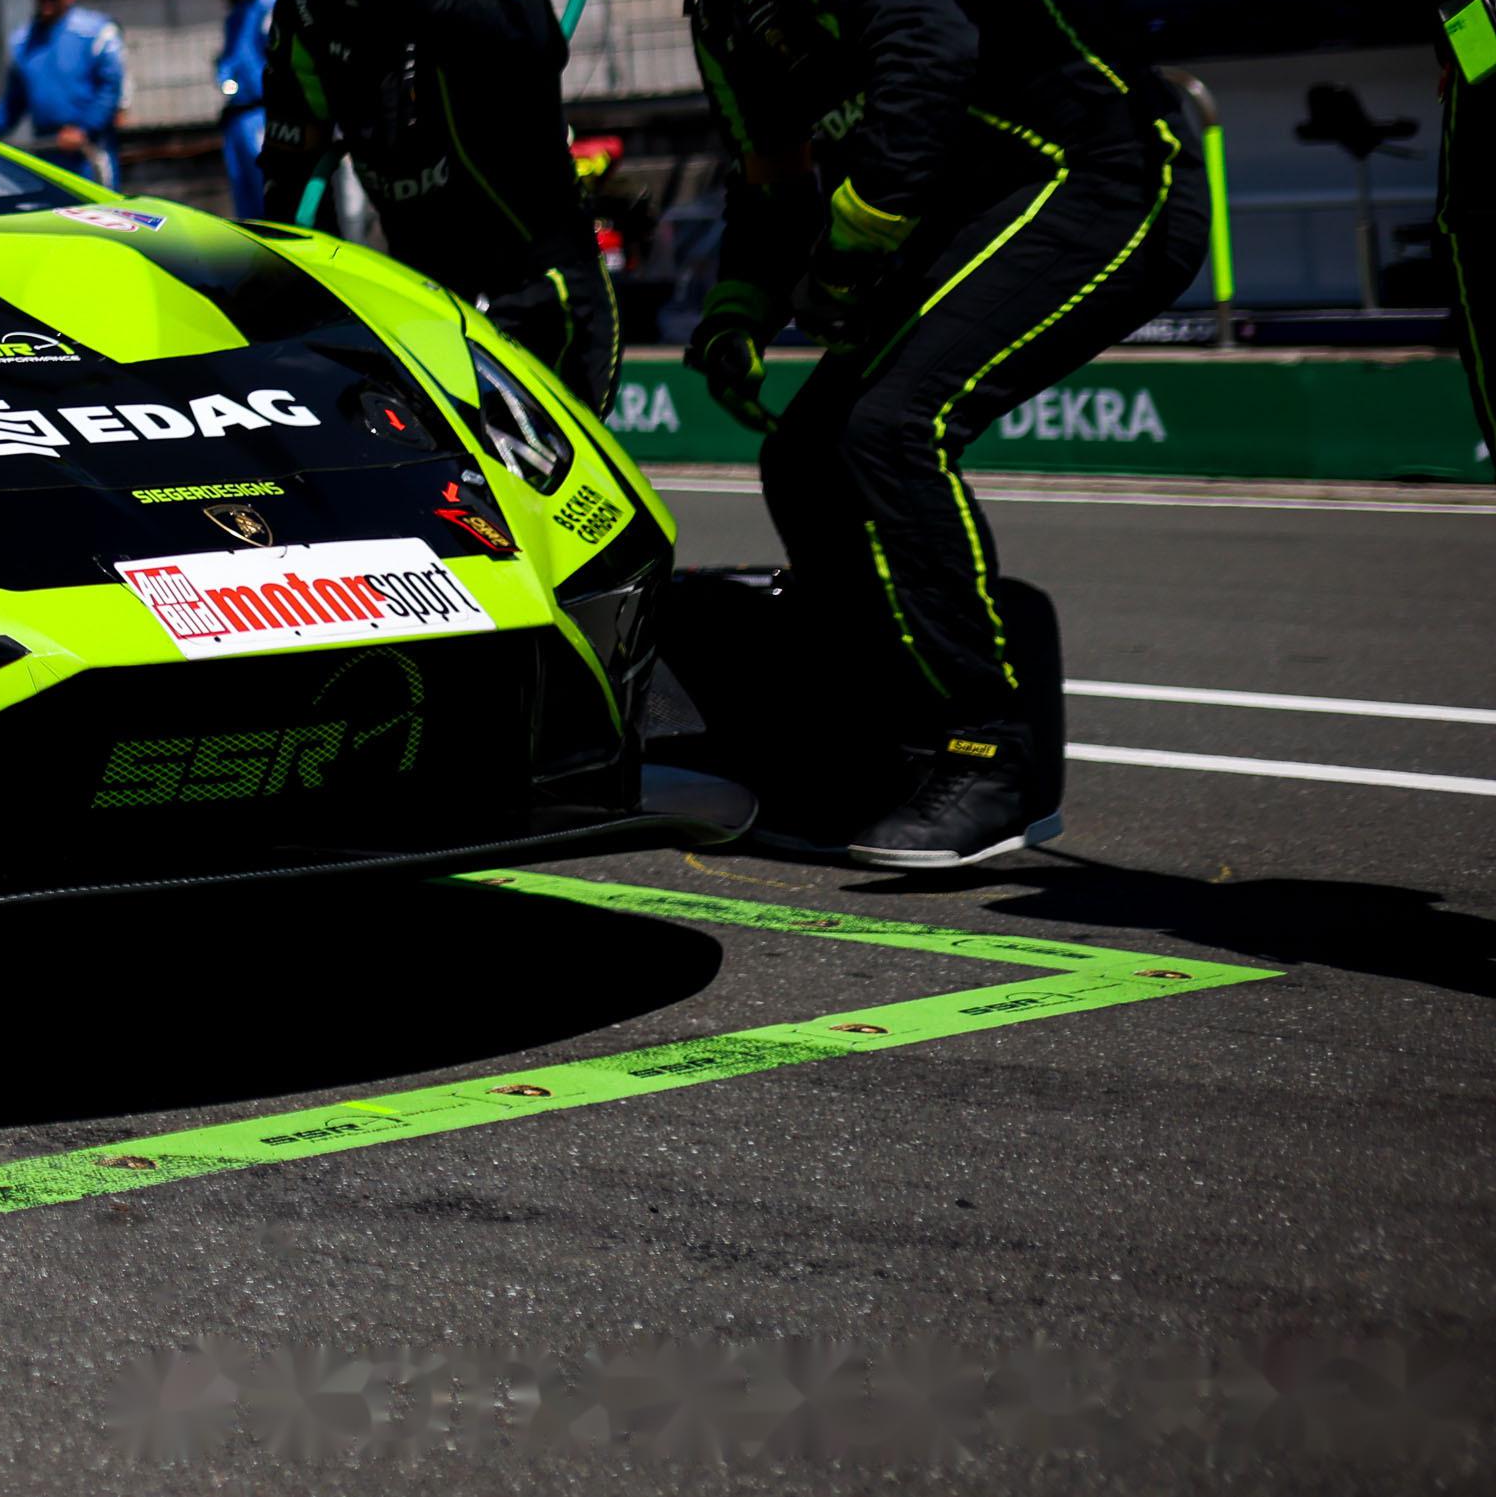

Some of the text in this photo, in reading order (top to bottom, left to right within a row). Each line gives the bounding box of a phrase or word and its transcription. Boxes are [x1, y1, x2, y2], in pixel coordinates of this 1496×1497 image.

[57, 389, 321, 444] EDAG
[998, 387, 1167, 442] DEKRA
[132, 482, 285, 504] SIEGERDESIGNS
[90, 720, 347, 808] SSR
[259, 1123, 359, 1145] SSR
